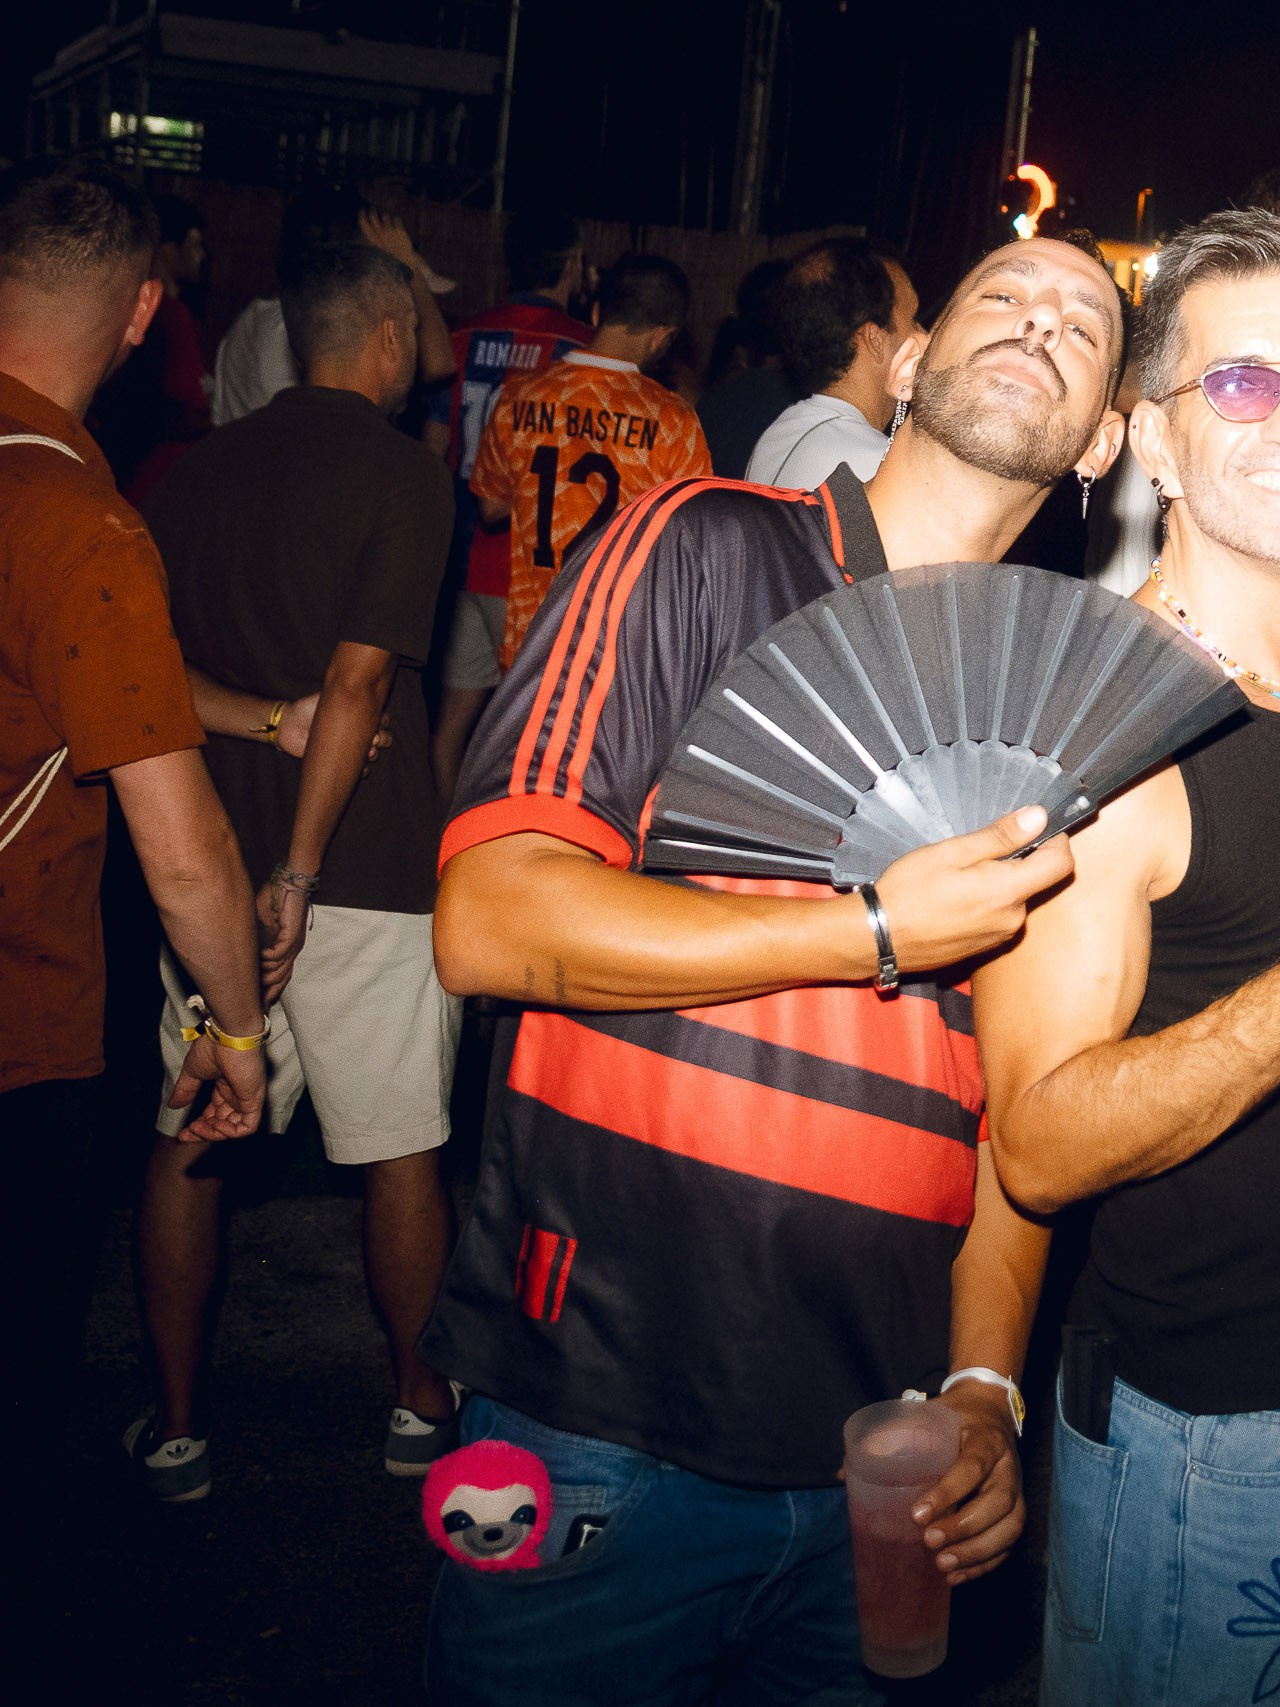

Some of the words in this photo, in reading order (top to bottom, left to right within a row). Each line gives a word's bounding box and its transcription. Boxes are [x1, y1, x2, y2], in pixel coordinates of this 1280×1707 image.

[474, 340, 542, 369] ROMARIO
[512, 401, 555, 434] VAN
[566, 405, 659, 451] BASTEN
[530, 446, 621, 569] 12
